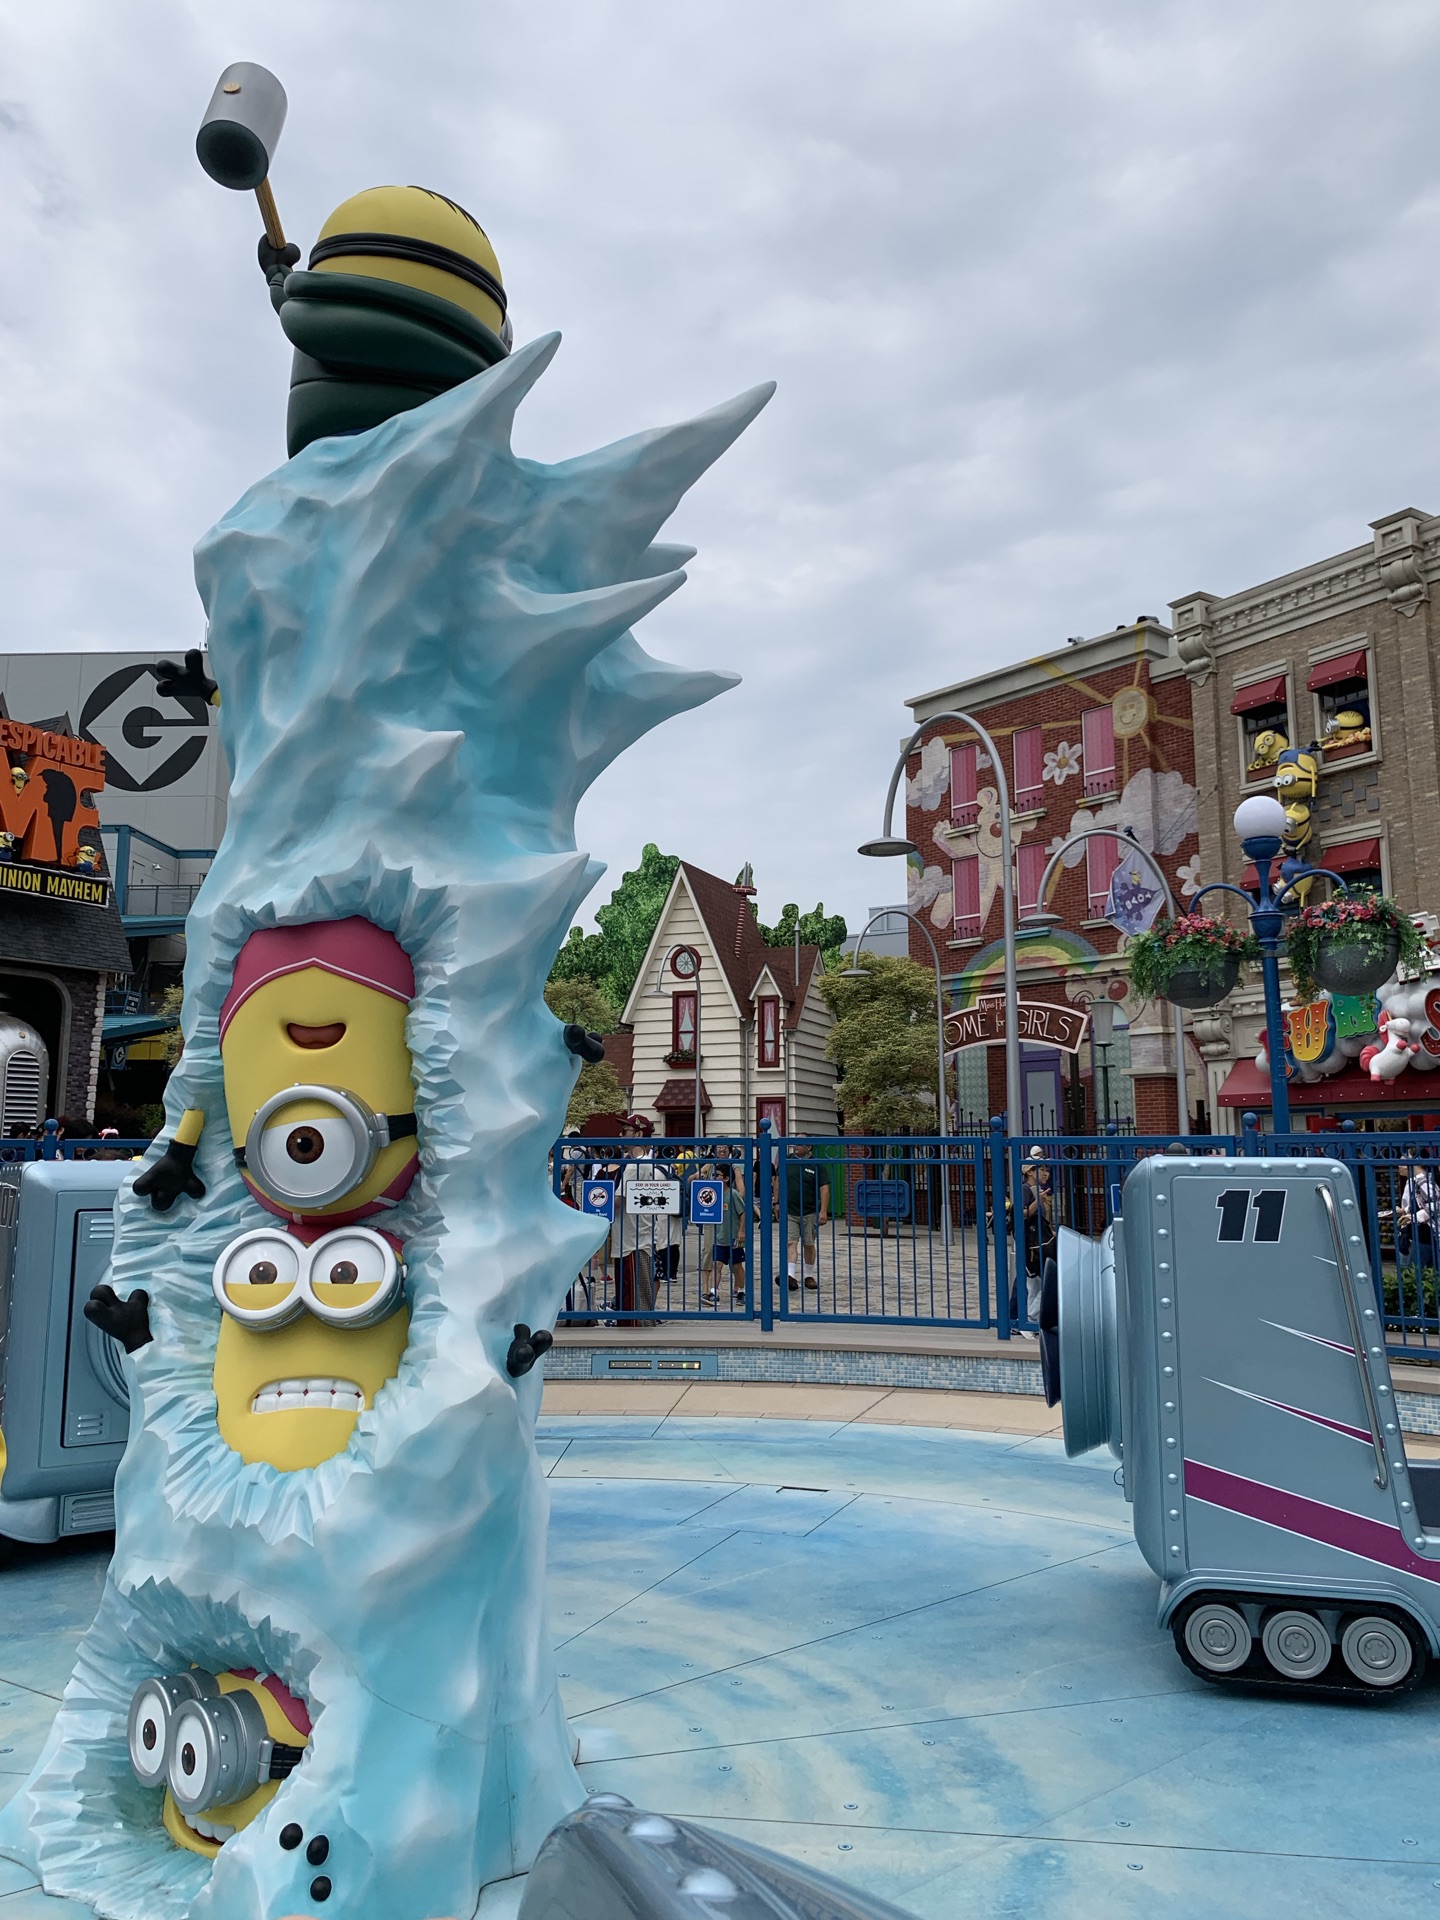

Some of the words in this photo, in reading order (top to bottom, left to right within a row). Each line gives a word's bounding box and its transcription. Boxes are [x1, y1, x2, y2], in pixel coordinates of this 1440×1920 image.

[0, 717, 106, 771] ESPICABLE
[0, 866, 42, 892] INION
[46, 875, 103, 903] MAYHEM
[943, 1012, 990, 1046] OME
[995, 1012, 1006, 1033] for
[1018, 1009, 1073, 1042] GIRLS
[1215, 1188, 1288, 1243] 11
